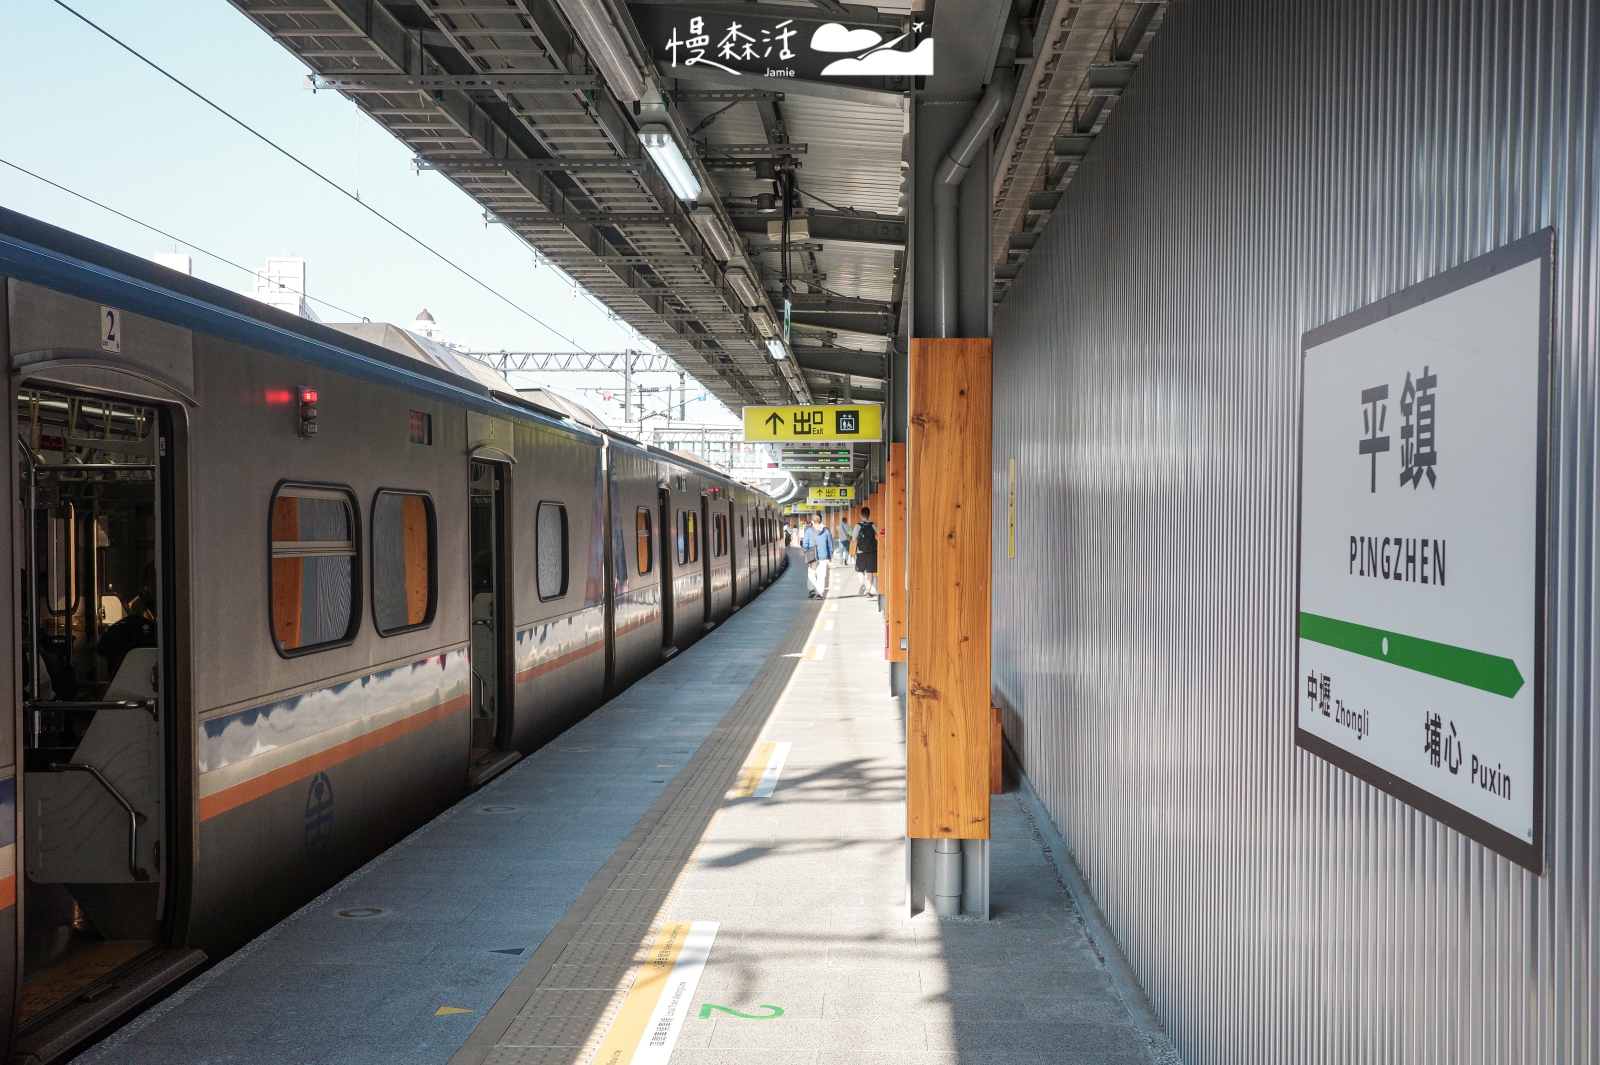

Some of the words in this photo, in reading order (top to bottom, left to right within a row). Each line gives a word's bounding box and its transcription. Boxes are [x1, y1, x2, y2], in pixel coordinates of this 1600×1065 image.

[106, 310, 116, 341] 2
[793, 410, 824, 435] 出口
[812, 427, 824, 435] Exit
[1358, 365, 1438, 494] 平鎮
[1349, 535, 1446, 587] PINGZHEN
[1307, 668, 1332, 719] 中壢
[1335, 698, 1370, 742] Zhongli
[1424, 710, 1462, 776] 埔心
[1471, 753, 1513, 801] Puxin
[698, 1003, 785, 1021] 2
